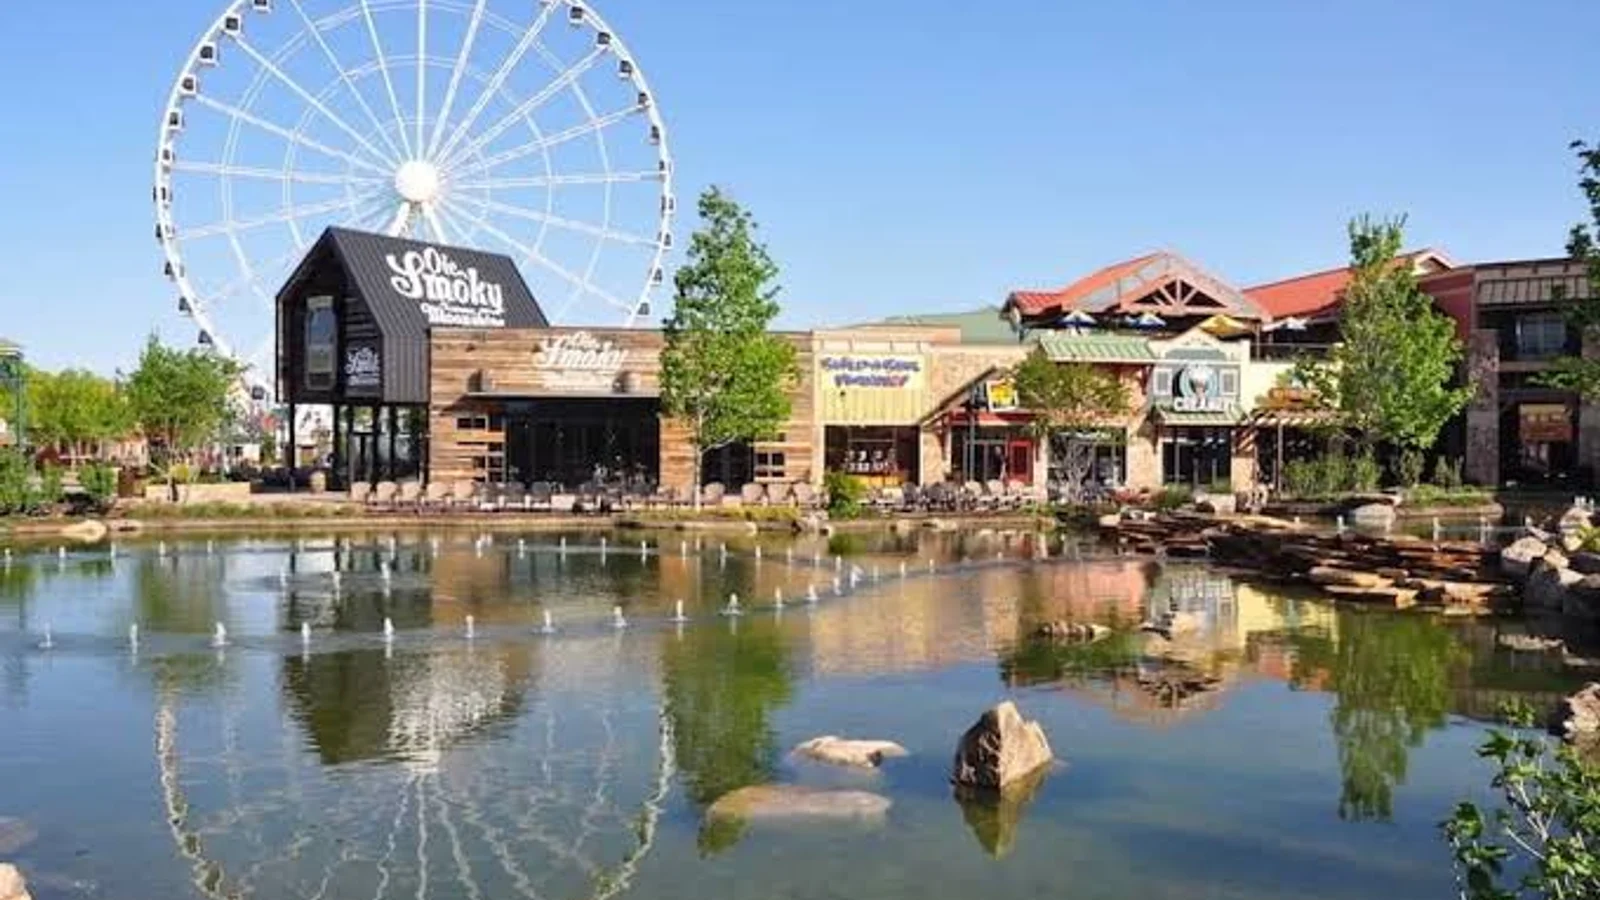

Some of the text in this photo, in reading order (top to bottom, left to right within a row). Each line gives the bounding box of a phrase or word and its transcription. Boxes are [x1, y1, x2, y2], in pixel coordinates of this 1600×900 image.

[423, 246, 459, 276] Ole
[385, 250, 503, 313] Smoky
[533, 335, 629, 369] Smoky
